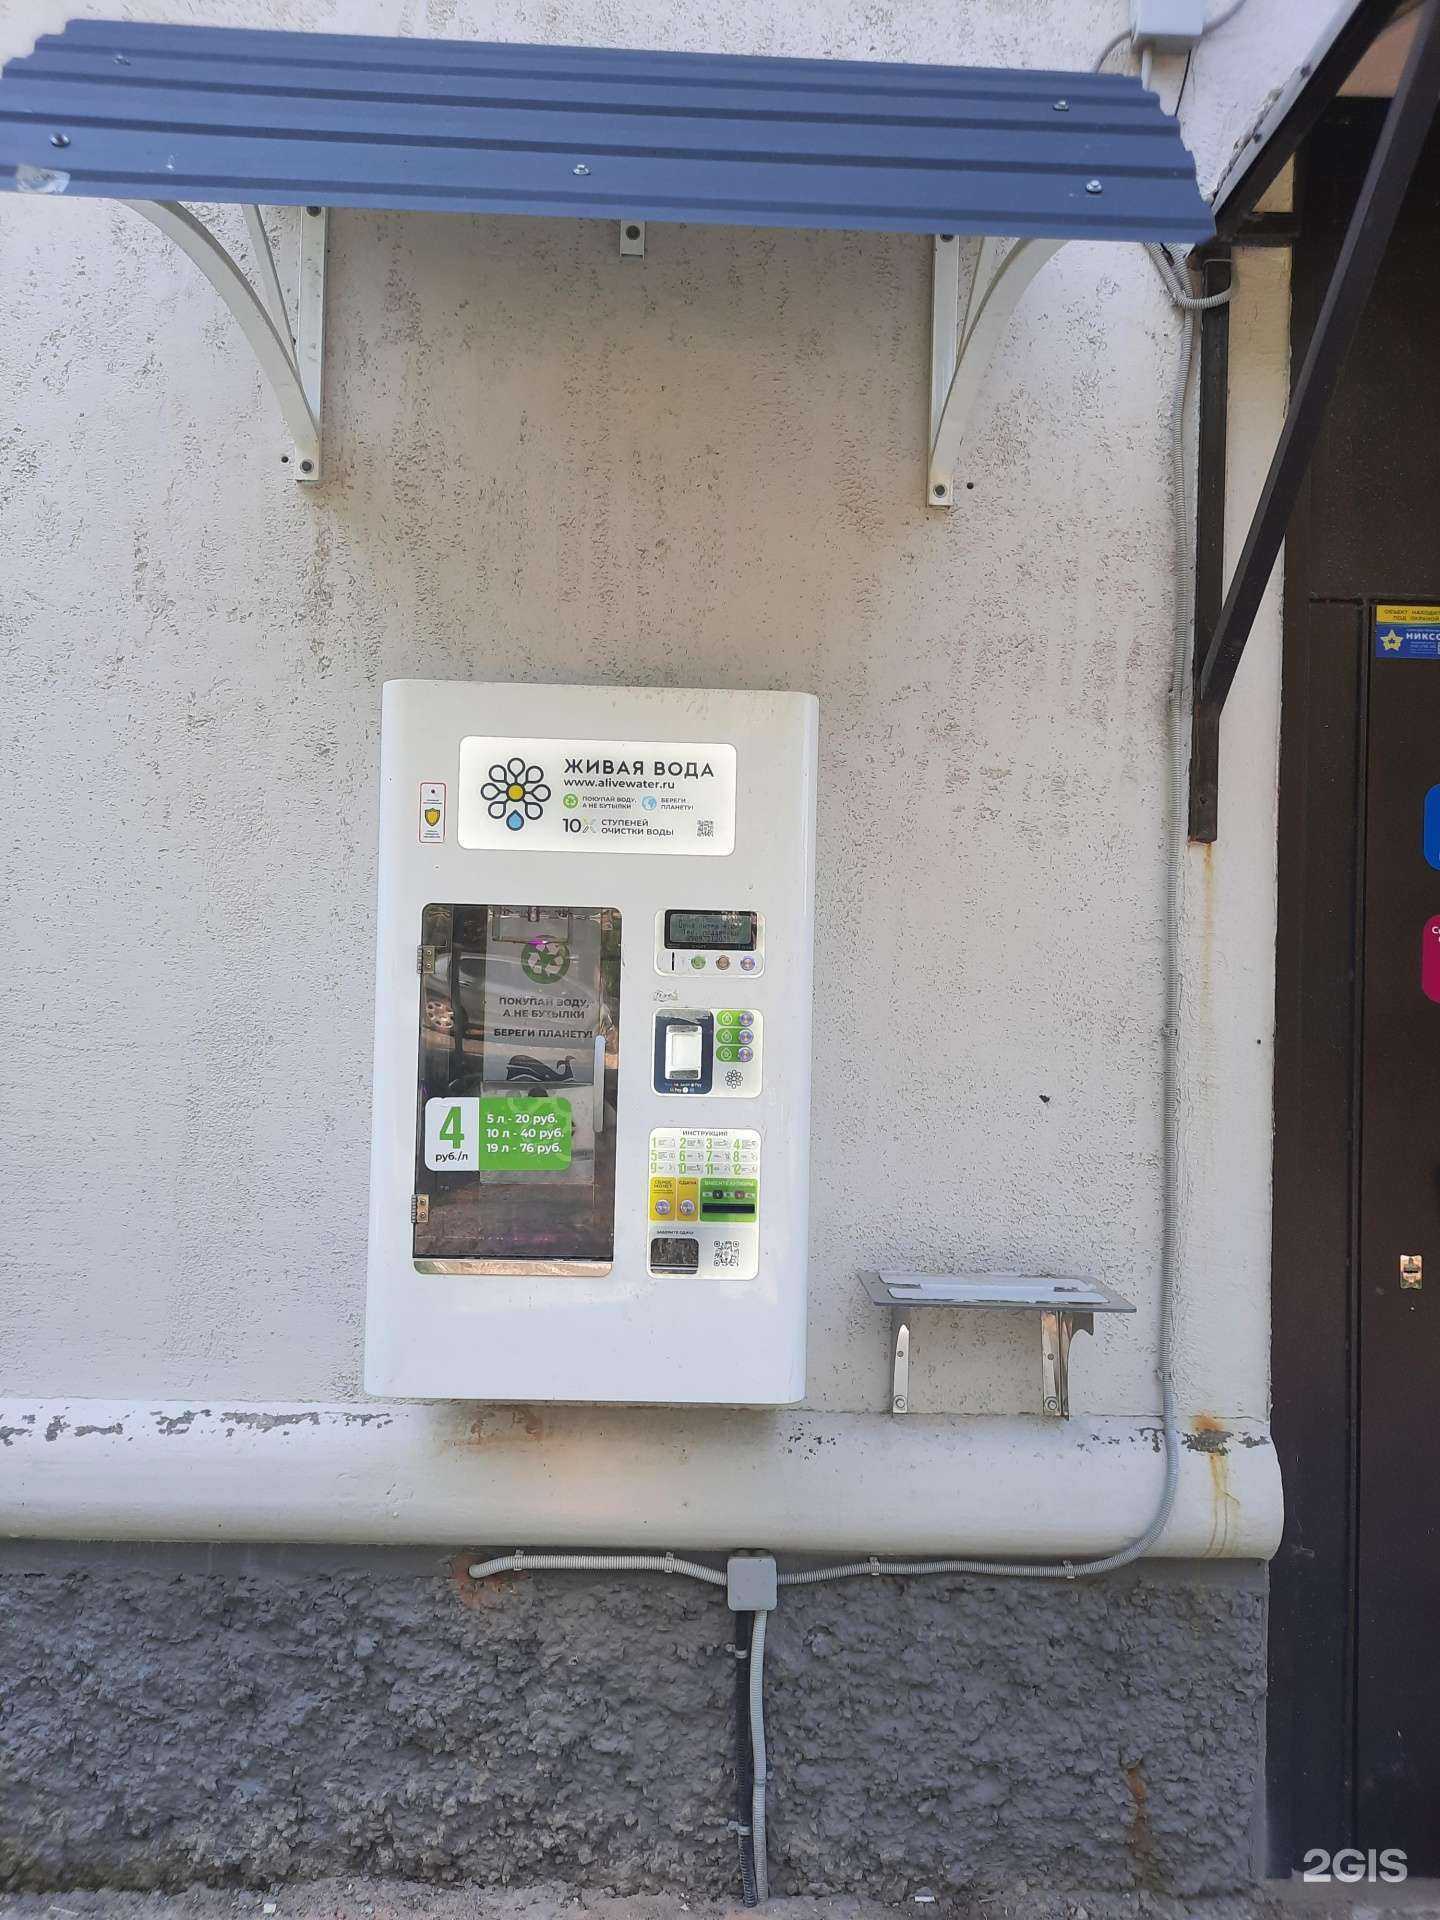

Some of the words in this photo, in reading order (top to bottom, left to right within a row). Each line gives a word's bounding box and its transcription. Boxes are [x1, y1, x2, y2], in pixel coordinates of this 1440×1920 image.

[564, 758, 644, 775] ЖИВАЯ
[654, 761, 714, 779] ВОДА
[563, 778, 675, 789] www.alivewater.ru
[601, 818, 649, 827] СТУПЕНЕЙ
[601, 827, 644, 835] ОЧИСТКИ
[647, 828, 674, 837] ВОДЫ
[503, 1009, 511, 1017] А
[514, 1009, 528, 1018] НЕ
[494, 1028, 535, 1038] БЕРЕГИ
[538, 1029, 593, 1039] ПЛАНЕТУ!
[487, 1114, 494, 1124] 5
[496, 1115, 504, 1124] л
[515, 1114, 529, 1124] 20
[533, 1113, 558, 1125] руб.
[440, 1106, 464, 1149] 4
[486, 1128, 499, 1138] 10
[502, 1130, 510, 1138] л
[521, 1128, 536, 1138] 40
[539, 1127, 564, 1140] руб.
[651, 1137, 657, 1148] 1
[680, 1138, 686, 1149] 2
[706, 1138, 712, 1149] 3
[733, 1139, 740, 1150] 4
[486, 1143, 498, 1153] 19
[501, 1145, 509, 1153] л
[520, 1143, 534, 1153] 76
[537, 1142, 562, 1155] руб.
[435, 1151, 468, 1162] руб./л
[651, 1150, 657, 1161] 5
[679, 1150, 686, 1161] 6
[706, 1151, 712, 1161] 7
[733, 1151, 739, 1162] 8
[651, 1162, 657, 1173] 9
[678, 1163, 686, 1174] 10
[705, 1164, 713, 1175] 11
